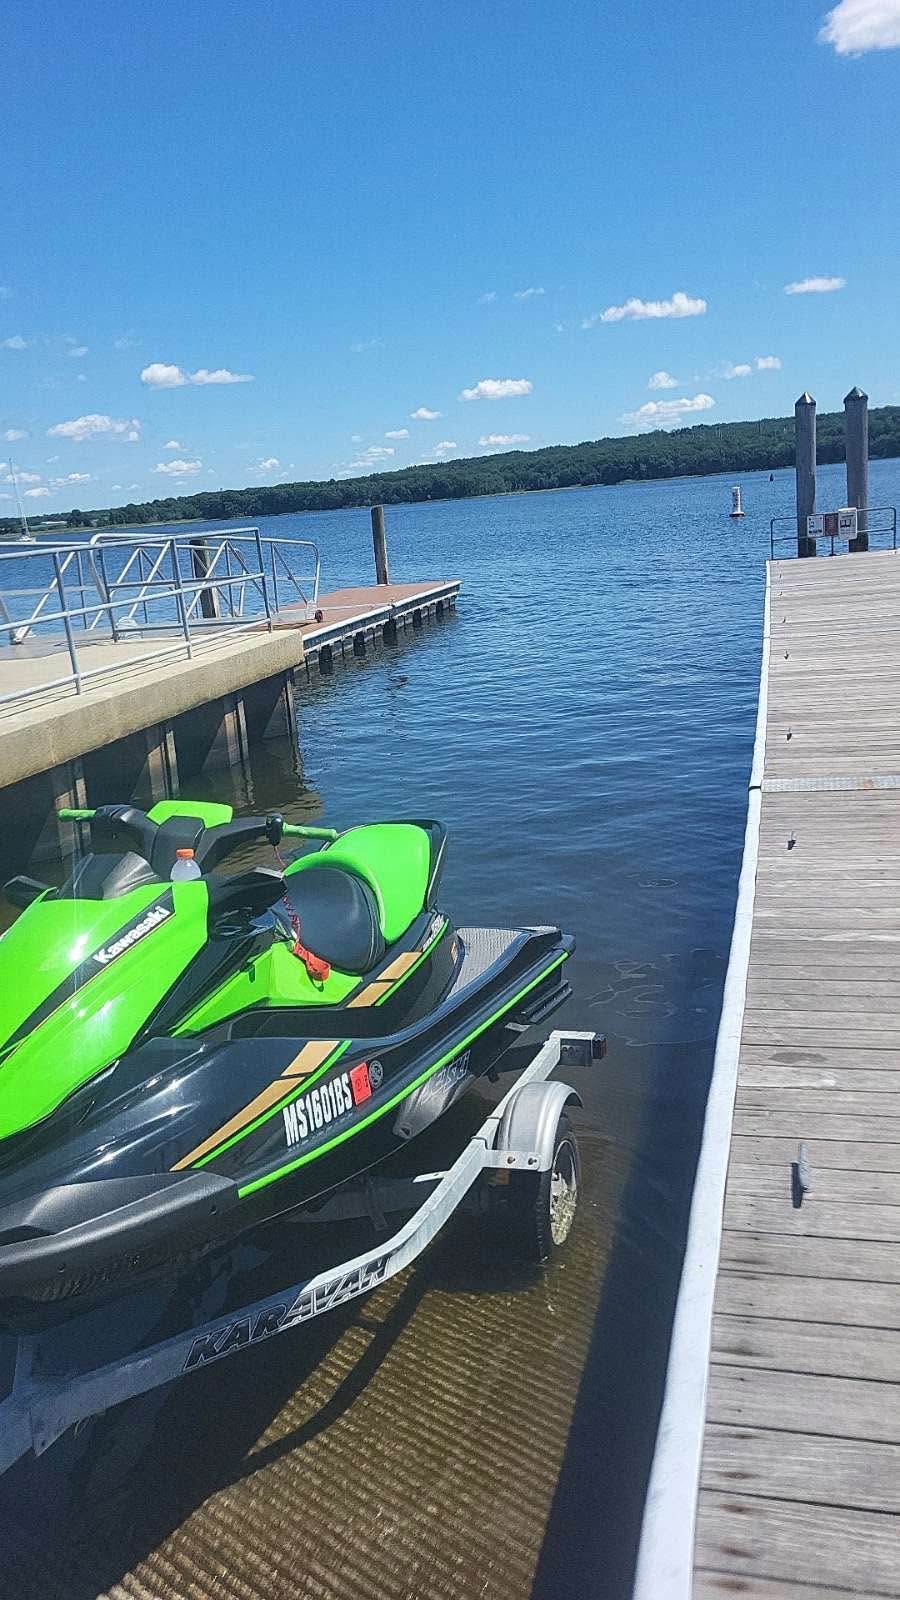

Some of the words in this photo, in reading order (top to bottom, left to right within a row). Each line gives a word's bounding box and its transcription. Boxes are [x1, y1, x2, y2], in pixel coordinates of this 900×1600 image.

[92, 905, 171, 964] Kawasaki
[282, 1072, 353, 1147] MS1601BS
[182, 1255, 390, 1371] KARAVAN
